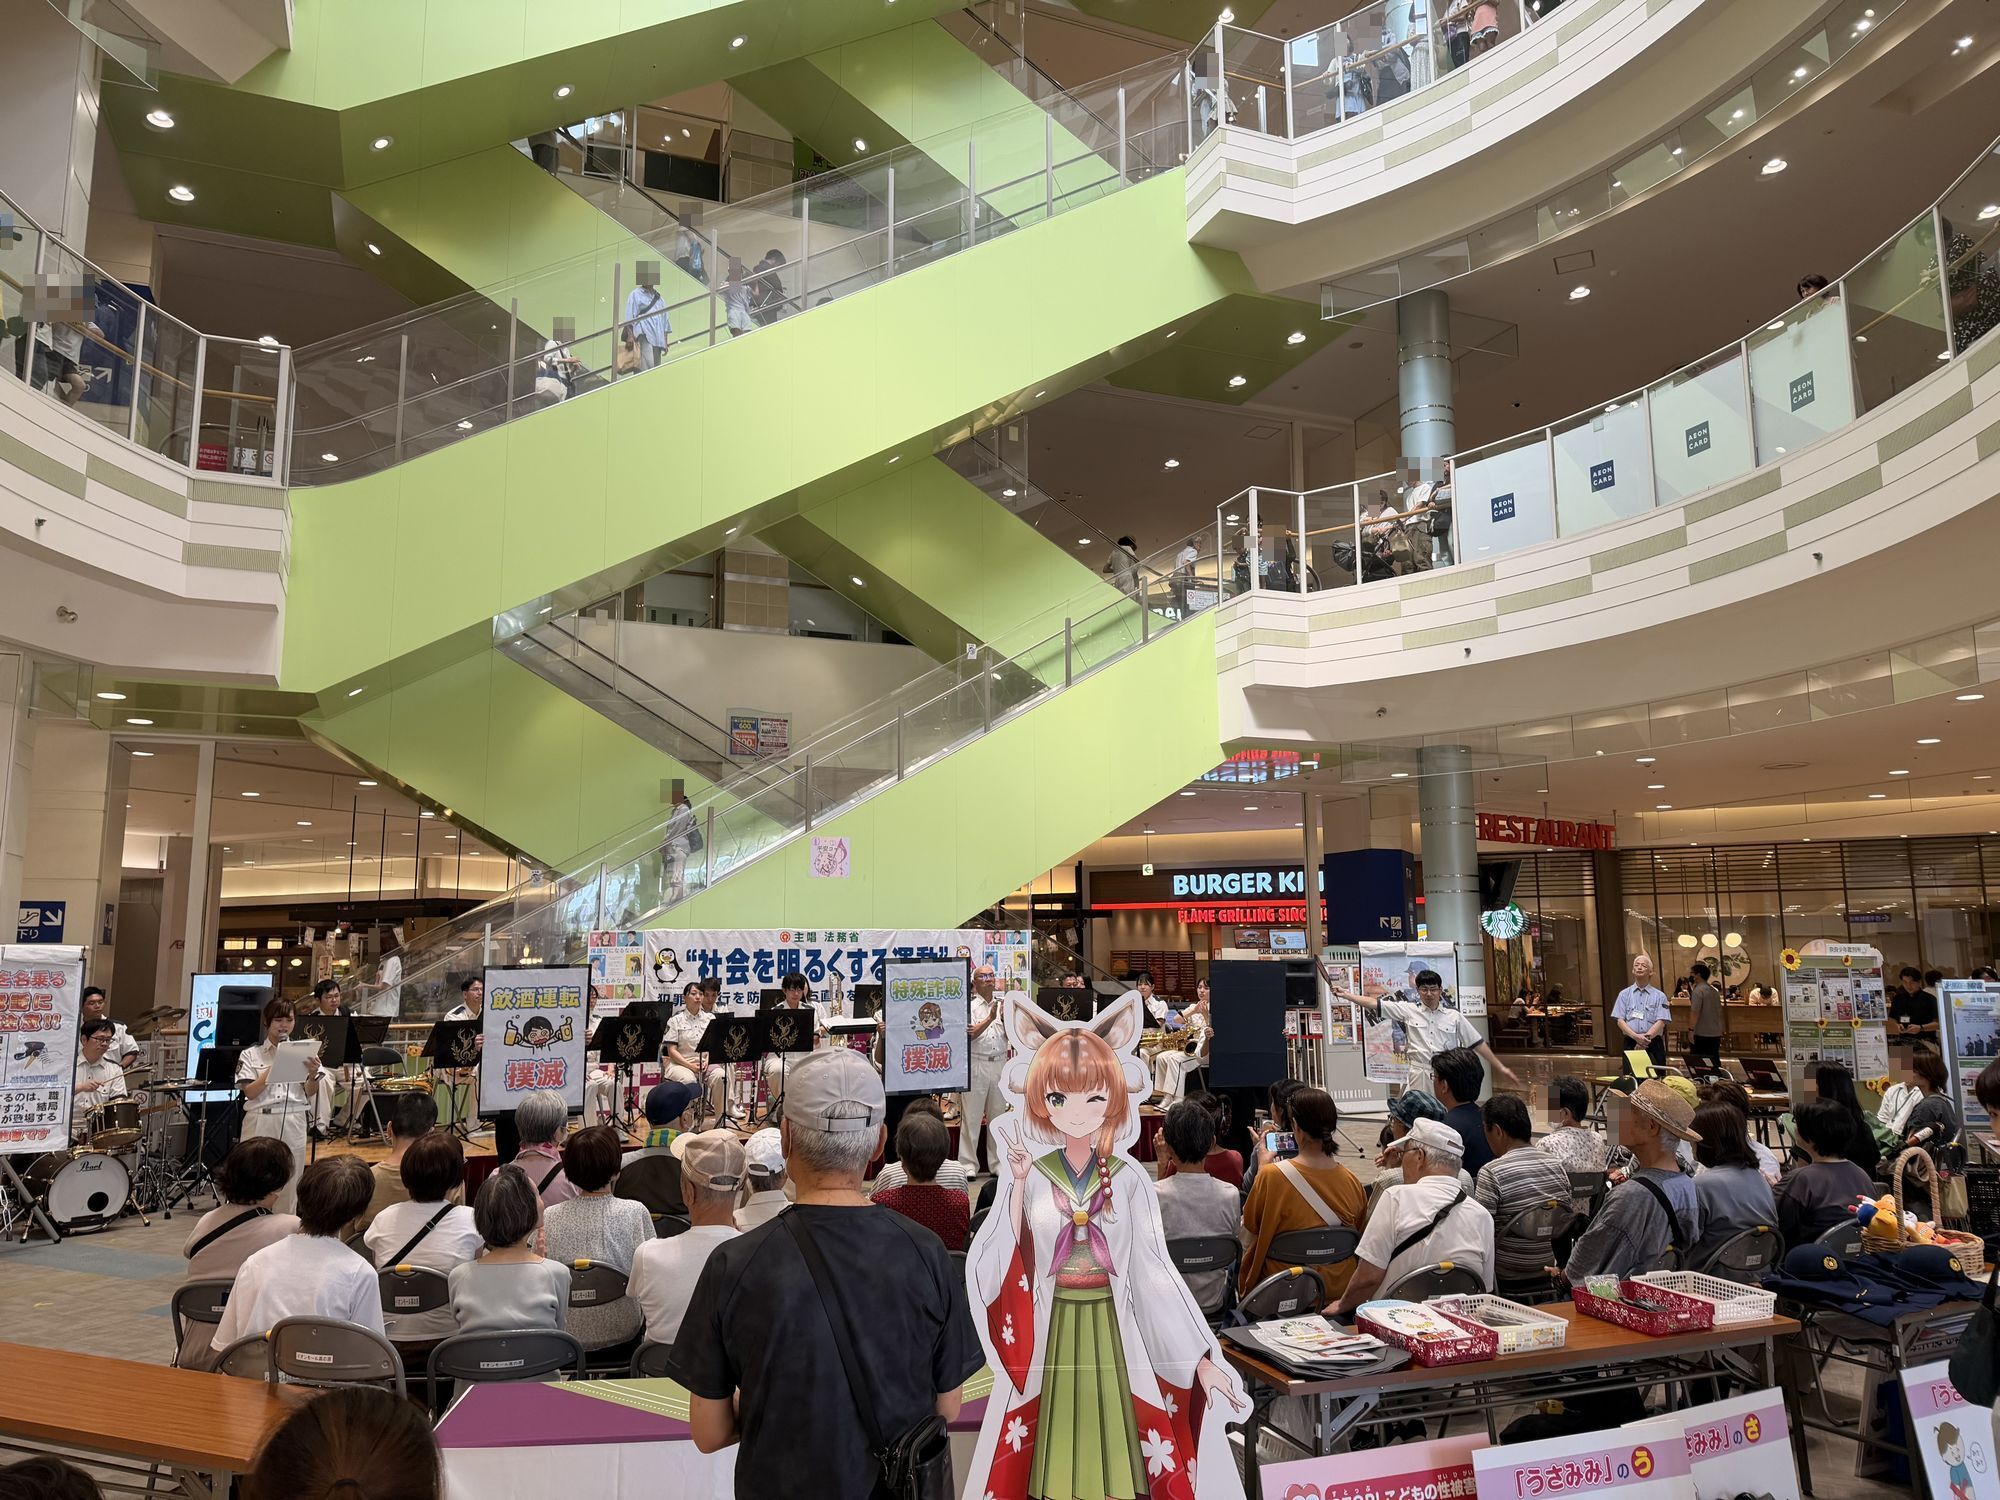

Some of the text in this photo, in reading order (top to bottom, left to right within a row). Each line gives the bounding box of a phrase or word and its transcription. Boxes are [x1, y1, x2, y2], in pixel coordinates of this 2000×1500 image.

[1791, 379, 1812, 394] AEON
[1792, 389, 1813, 404] CARD
[1688, 427, 1708, 441] AEON
[1688, 437, 1708, 450] CARD
[1592, 466, 1613, 478] AEON
[1593, 475, 1613, 486] CARD
[1493, 499, 1513, 509] AEON
[1493, 507, 1513, 517] CARD
[1478, 812, 1616, 852] RESTAURANT
[1173, 871, 1325, 896] BURGER KI
[1178, 908, 1215, 924] FLAME
[1218, 908, 1275, 923] GRILLING
[1278, 907, 1308, 922] SINC
[17, 929, 39, 940] 下り
[793, 931, 860, 943] 主唱 法務省
[1390, 930, 1403, 938] 上り
[891, 977, 963, 1001] 特殊詐欺
[490, 986, 581, 1010] 飲酒運転
[902, 1042, 952, 1074] 撲滅
[504, 1057, 567, 1092] 撲滅
[80, 1161, 103, 1171] Pearl
[1514, 1450, 1652, 1498] 「うさみみ」のう
